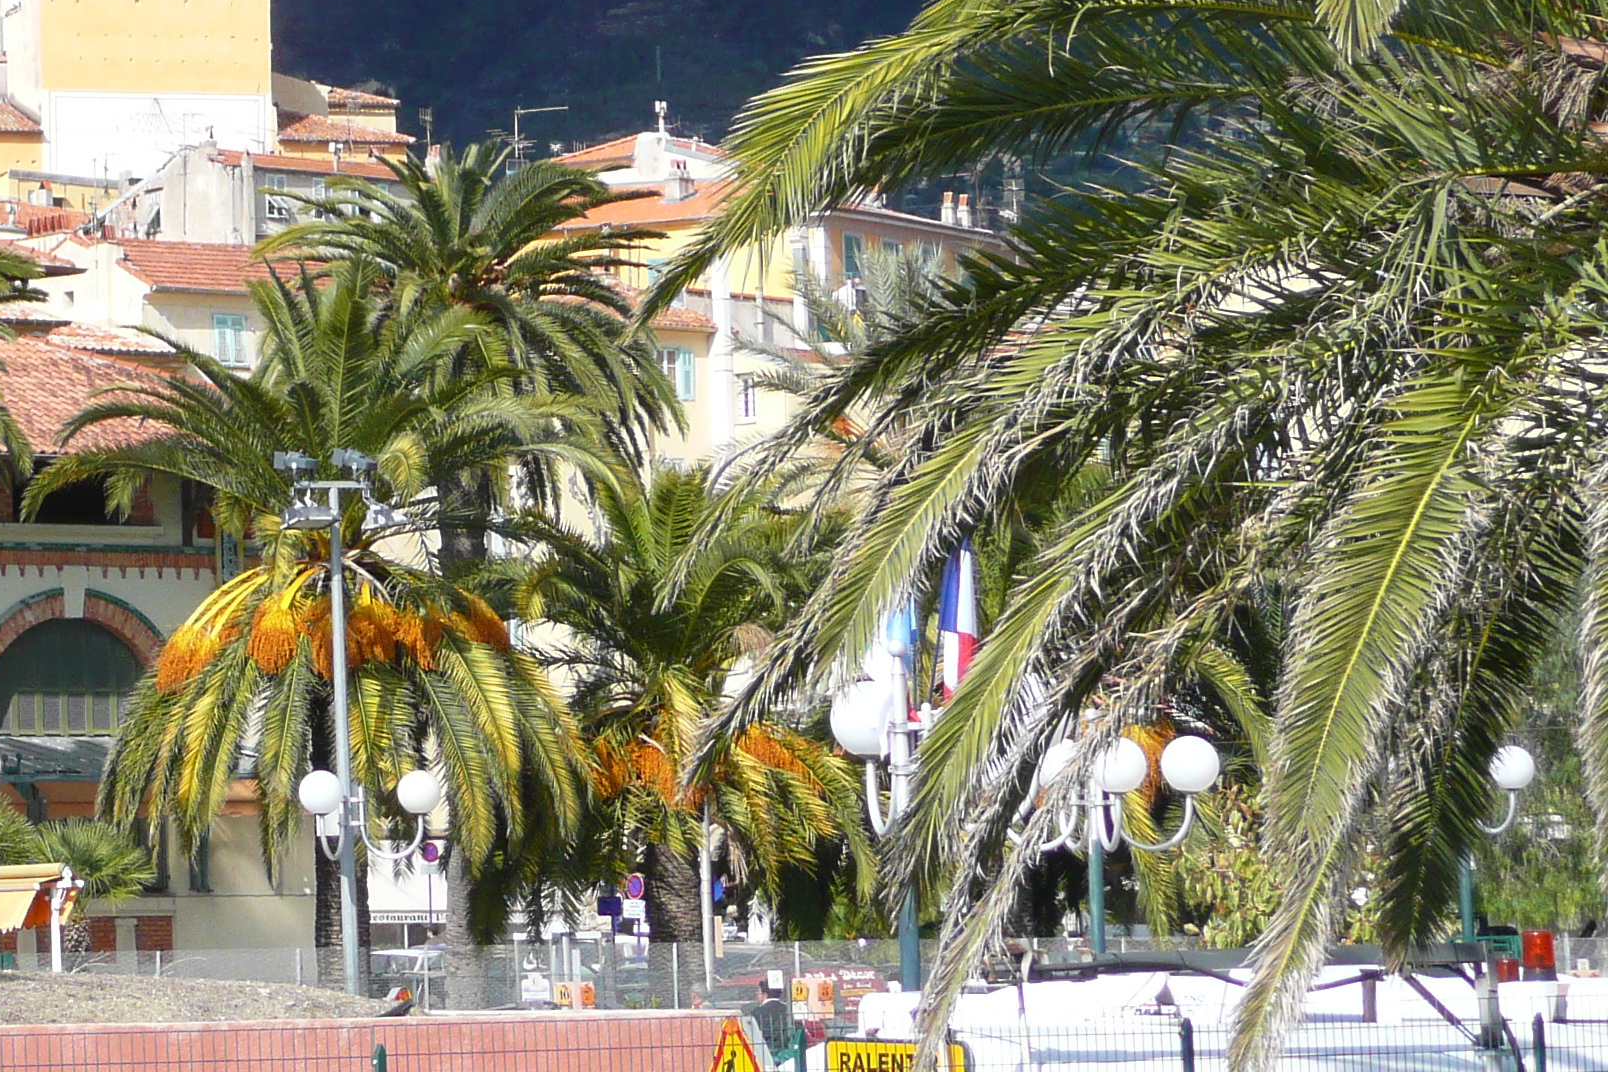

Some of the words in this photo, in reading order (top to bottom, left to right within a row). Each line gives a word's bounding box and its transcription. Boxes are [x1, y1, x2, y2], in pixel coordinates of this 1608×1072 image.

[372, 913, 429, 922] estaurant
[795, 986, 803, 996] 9
[839, 1052, 938, 1072] RALENT
